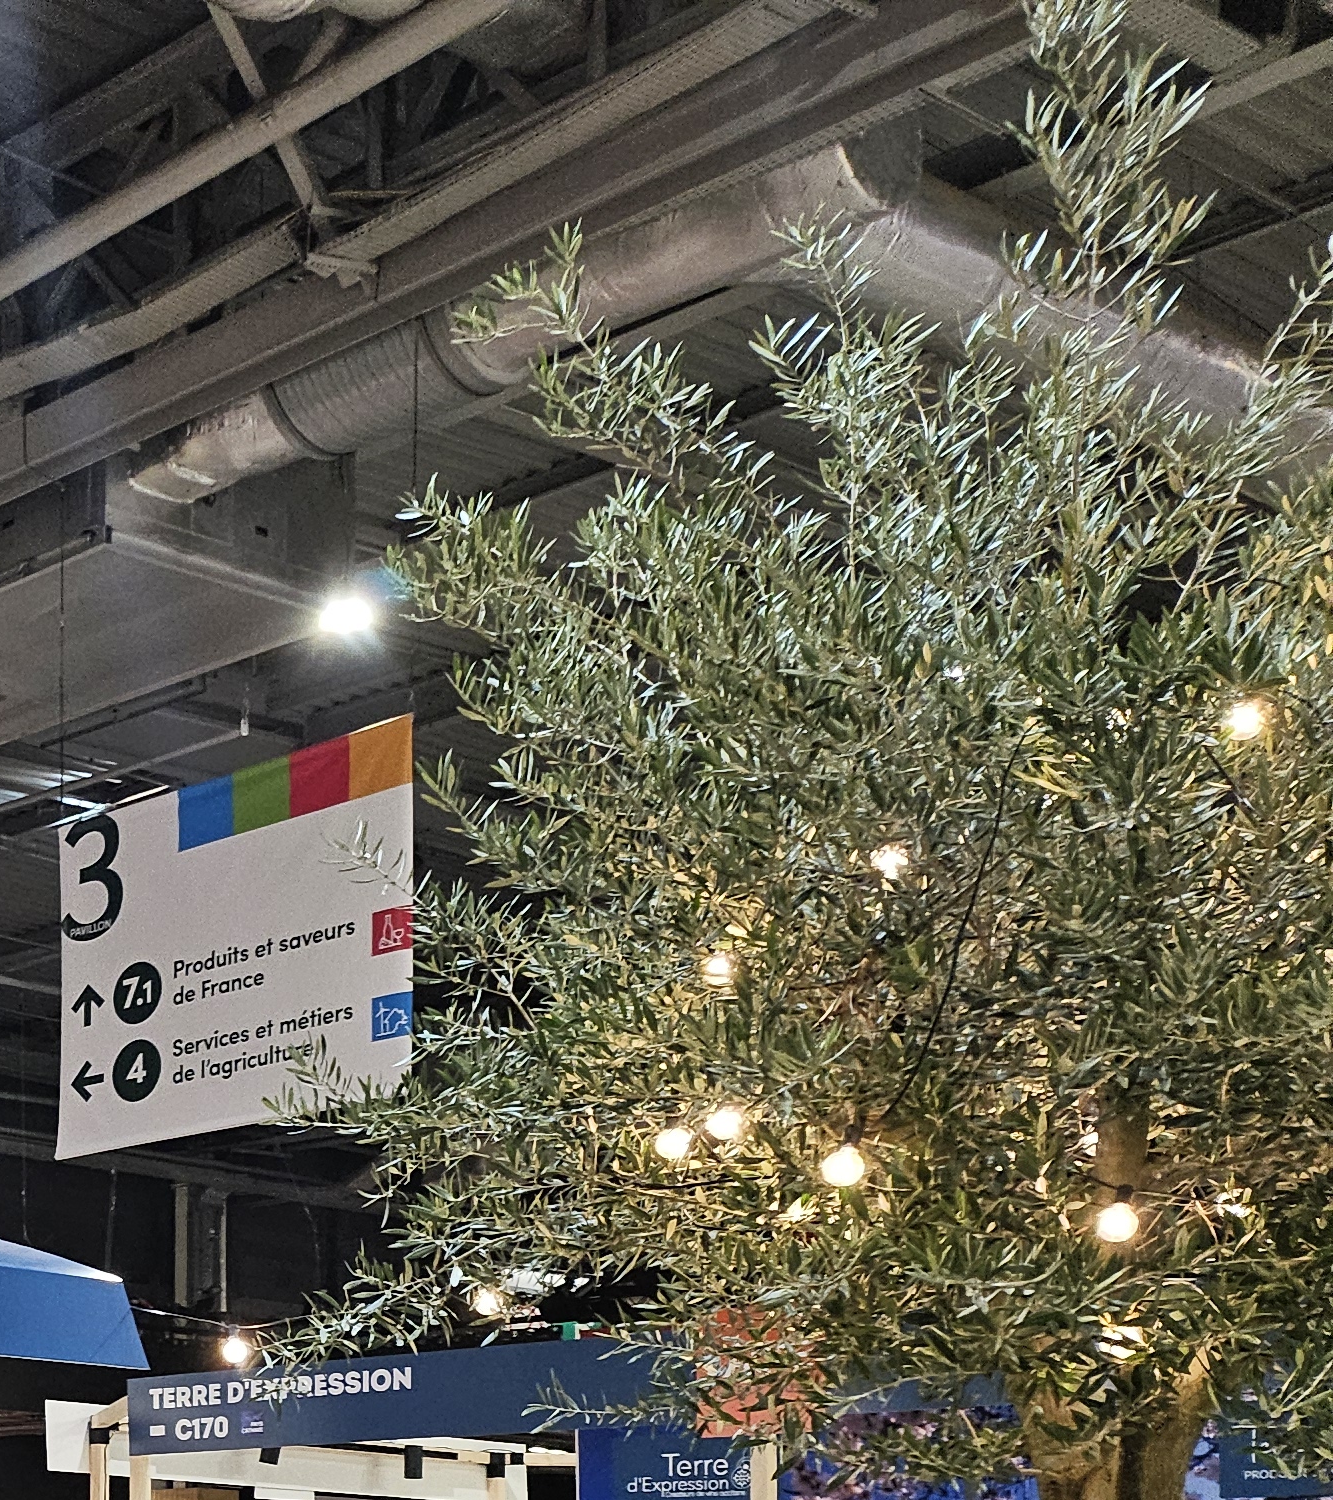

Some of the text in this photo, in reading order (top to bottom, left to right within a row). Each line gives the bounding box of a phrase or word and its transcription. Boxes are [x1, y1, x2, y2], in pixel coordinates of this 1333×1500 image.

[61, 814, 123, 942] 3
[70, 919, 112, 938] PAVILLON
[173, 920, 356, 980] Produits et saveurs
[122, 975, 154, 1010] 7.1
[173, 970, 264, 1006] de France
[172, 1003, 354, 1058] Services et métiers
[126, 1053, 146, 1085] 4
[172, 1065, 194, 1085] de
[149, 1383, 221, 1410] TERRE
[175, 1415, 229, 1441] C170
[661, 1453, 729, 1477] Terre
[626, 1476, 729, 1496] d'Expression
